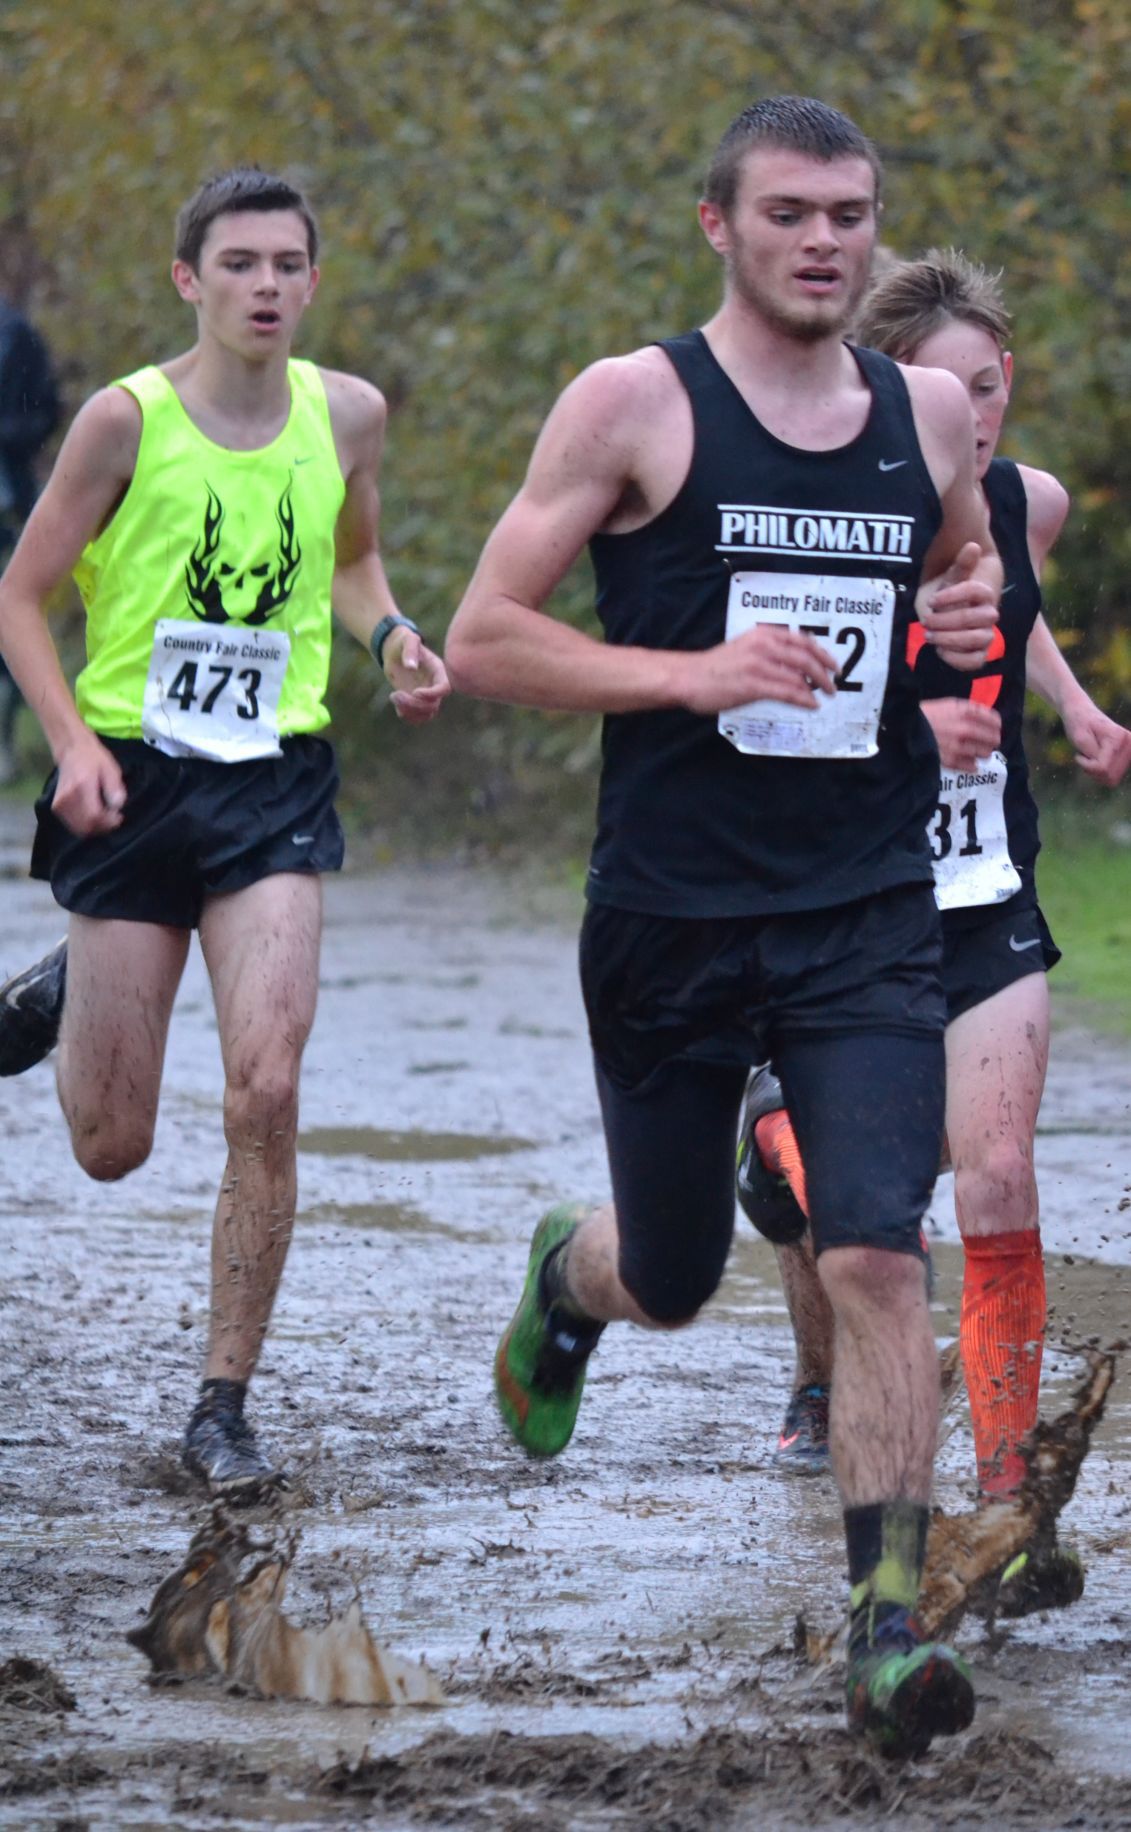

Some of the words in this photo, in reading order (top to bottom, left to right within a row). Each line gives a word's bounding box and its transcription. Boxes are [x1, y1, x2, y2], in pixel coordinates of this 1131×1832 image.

[720, 512, 911, 554] PHILOMATH
[741, 591, 799, 612] Country
[803, 595, 830, 613] Fair
[835, 597, 883, 615] Classic
[163, 635, 212, 653] Country
[216, 641, 239, 657] Fair
[241, 644, 281, 660] Classic
[167, 659, 262, 720] 473
[956, 771, 998, 789] Classic
